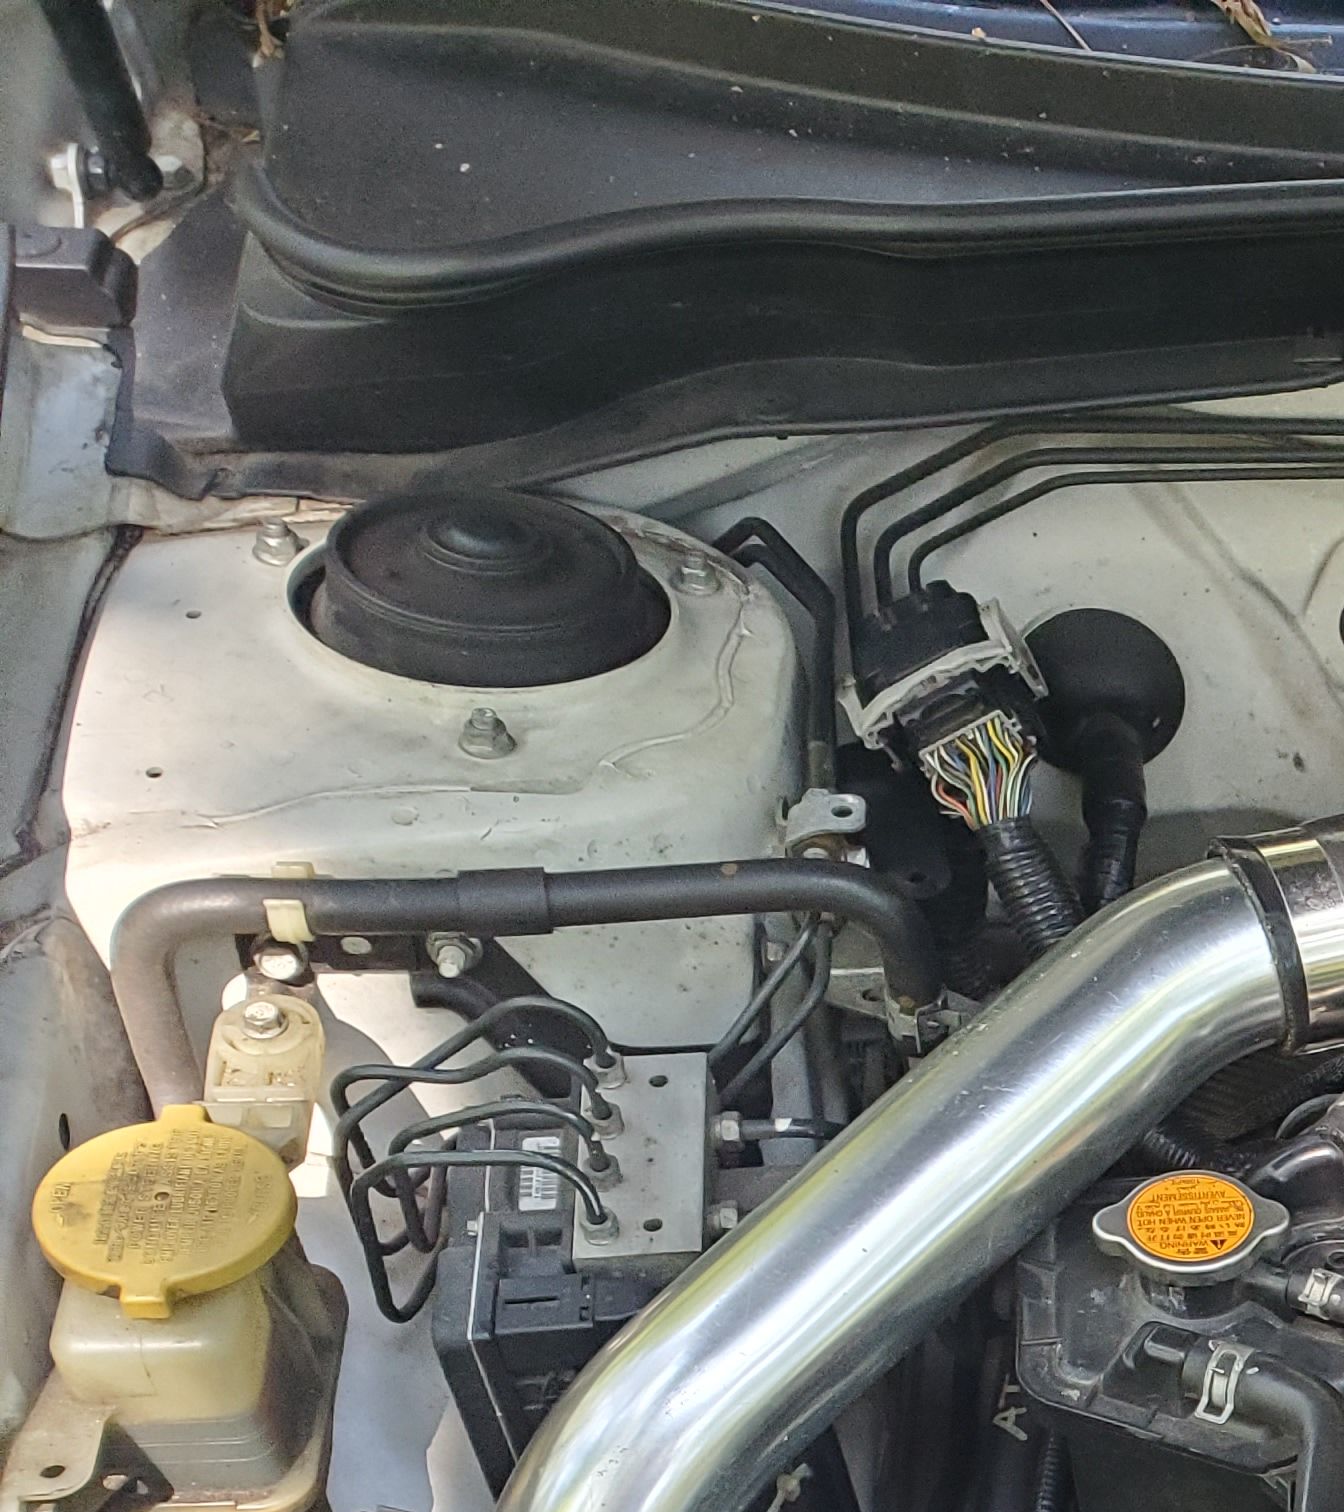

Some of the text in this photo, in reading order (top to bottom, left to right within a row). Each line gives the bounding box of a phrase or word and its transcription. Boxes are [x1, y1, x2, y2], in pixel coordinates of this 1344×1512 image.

[1149, 1189, 1225, 1202] AVERTISSEMENT
[1159, 1216, 1186, 1225] WHEN
[1189, 1215, 1213, 1223] OPEN
[1216, 1212, 1245, 1221] NEVER
[1159, 1238, 1208, 1249] WARNING
